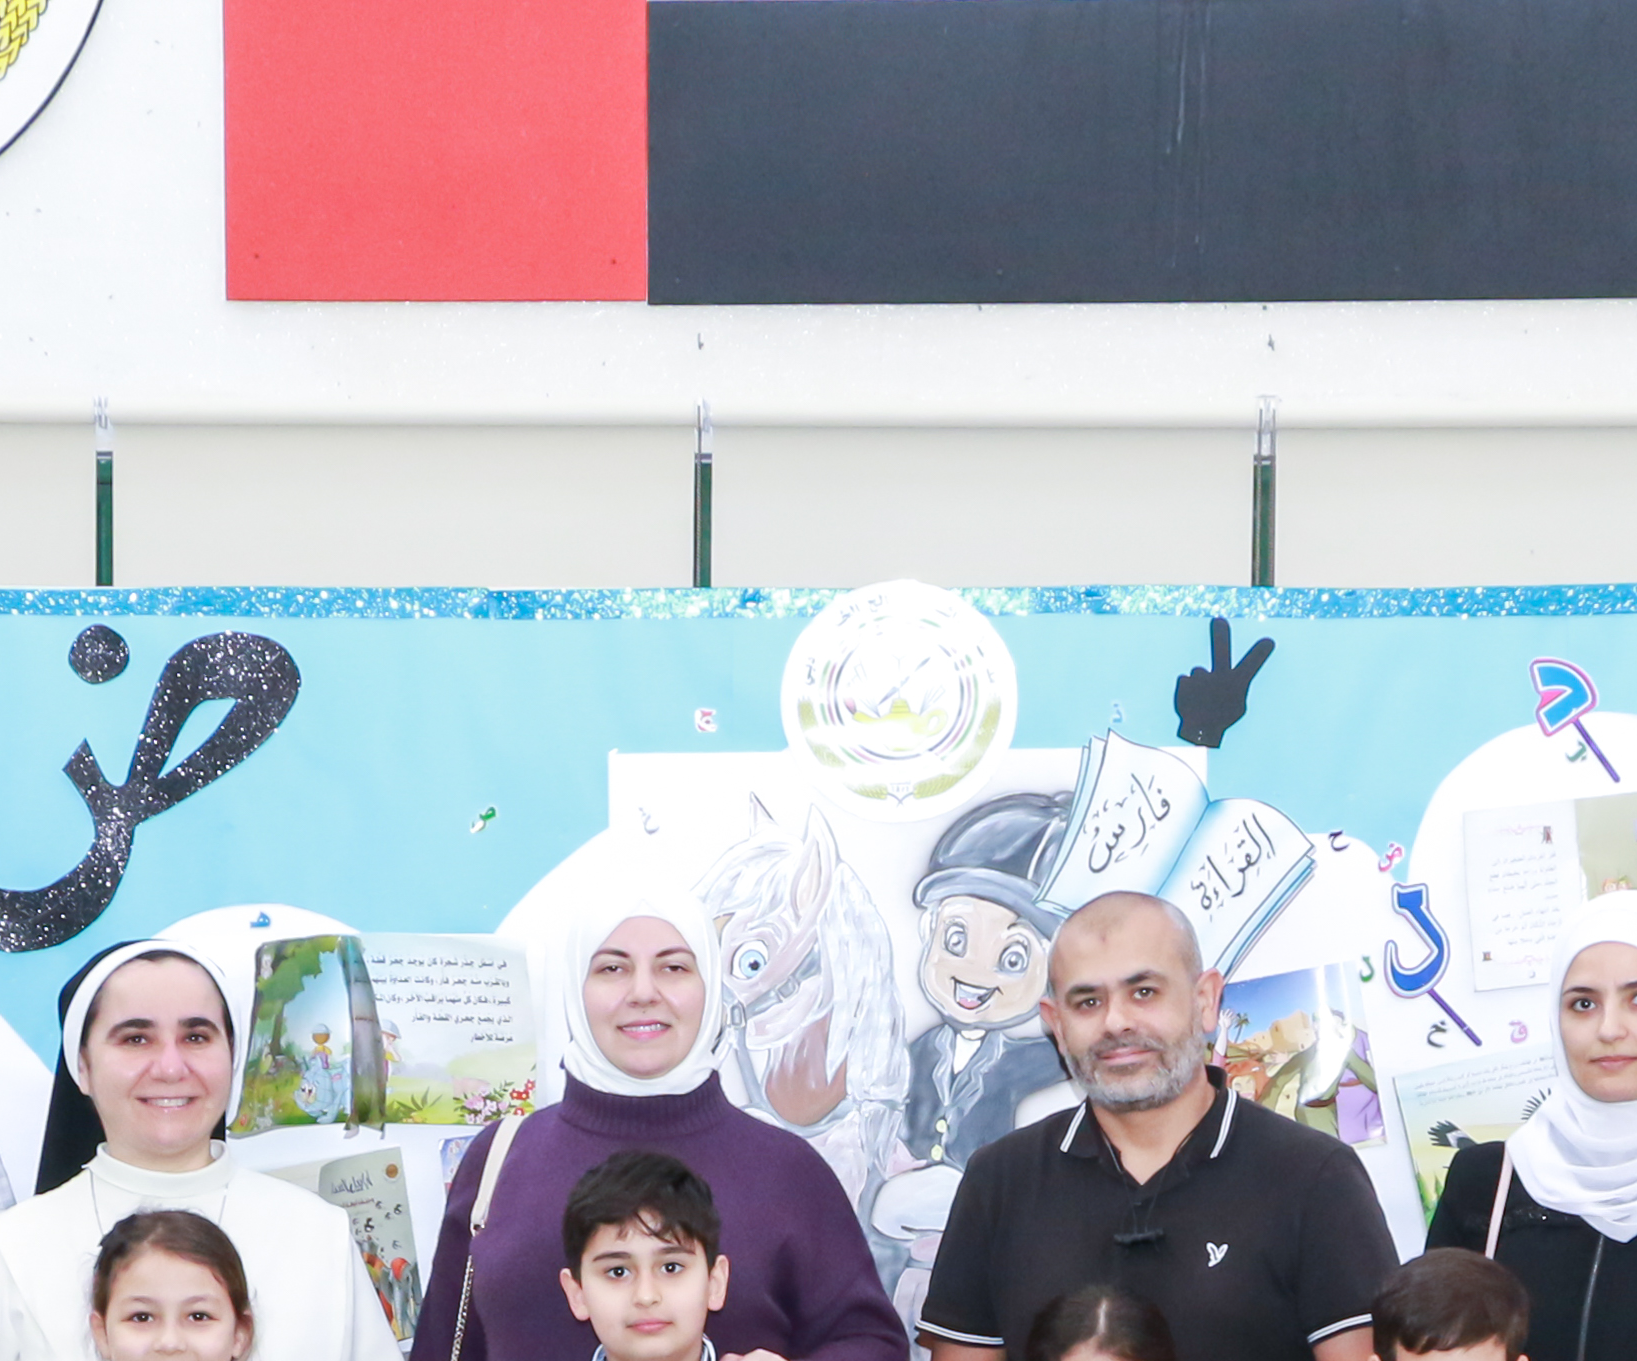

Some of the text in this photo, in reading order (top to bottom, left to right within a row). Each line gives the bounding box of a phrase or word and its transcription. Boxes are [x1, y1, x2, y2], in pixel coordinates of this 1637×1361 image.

[1530, 656, 1599, 737] د
[1328, 829, 1351, 852] ح
[1383, 882, 1451, 999] ل
